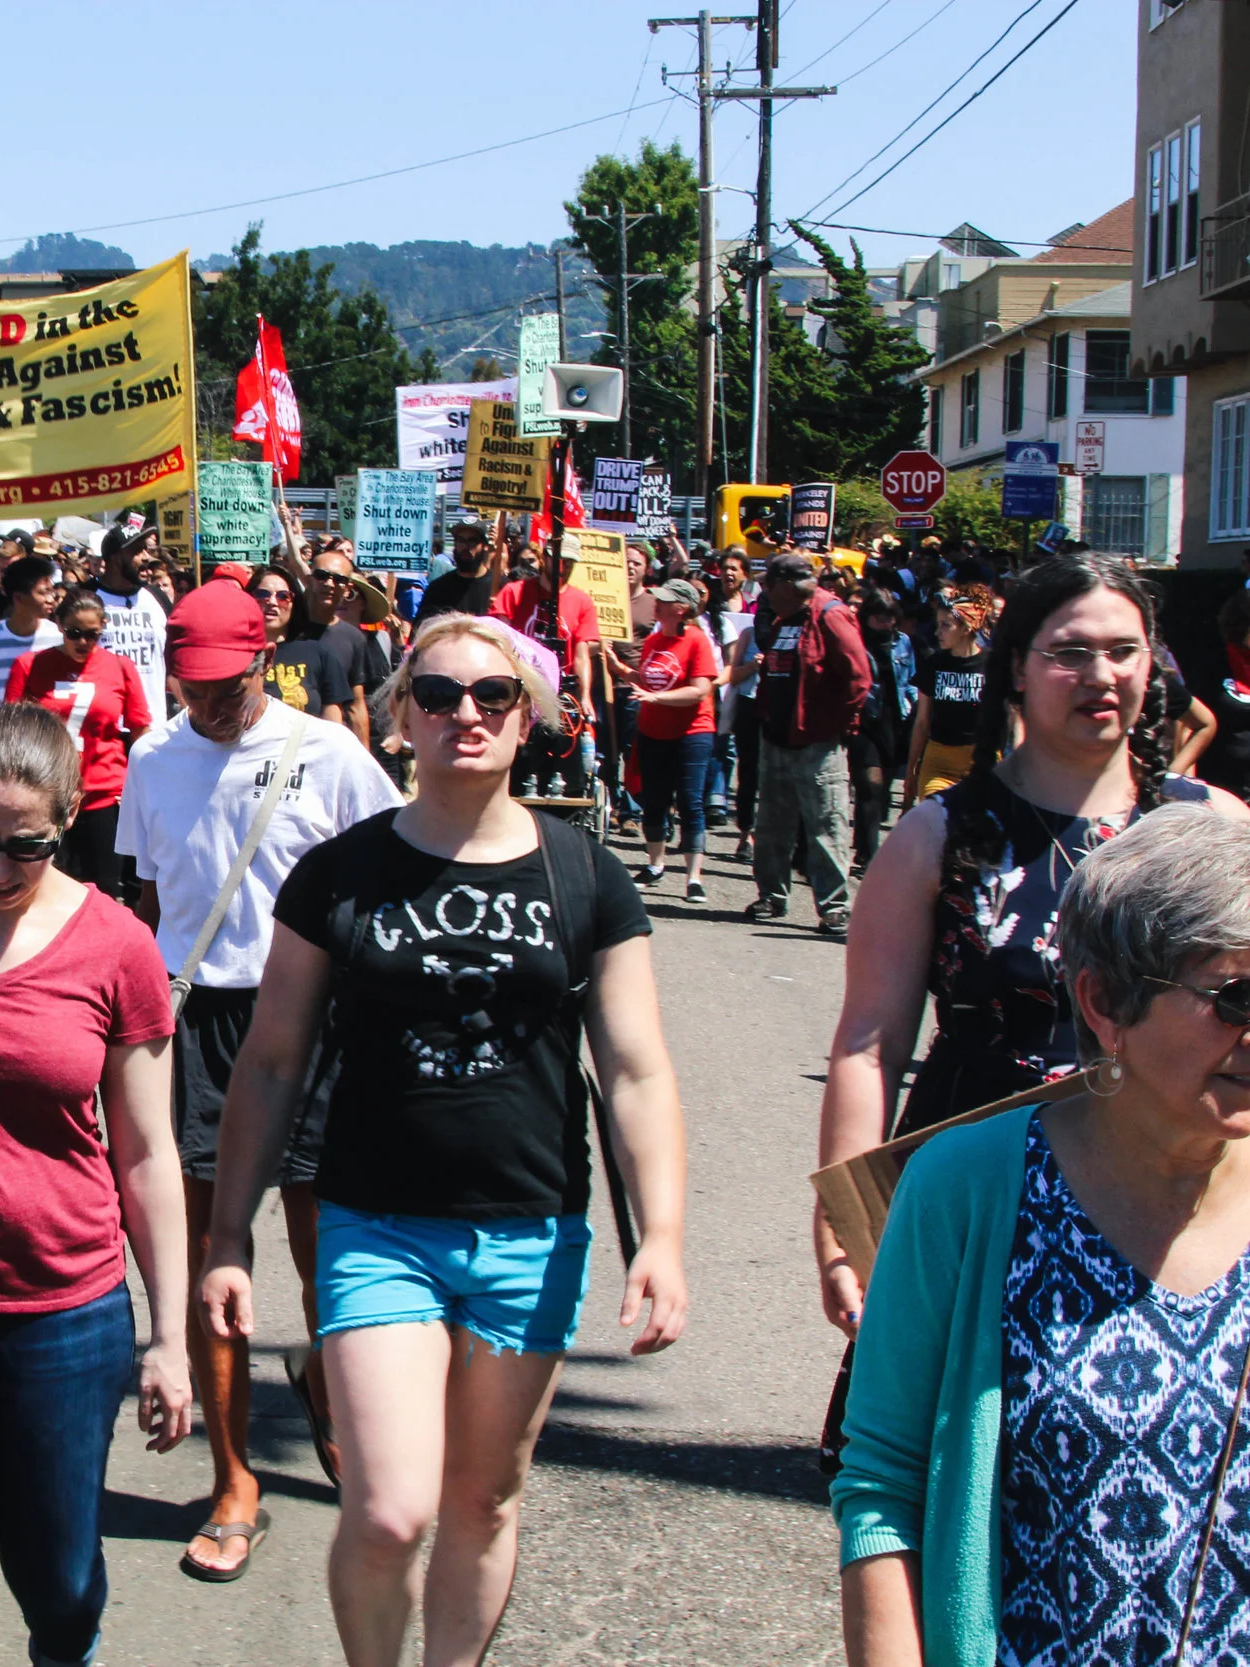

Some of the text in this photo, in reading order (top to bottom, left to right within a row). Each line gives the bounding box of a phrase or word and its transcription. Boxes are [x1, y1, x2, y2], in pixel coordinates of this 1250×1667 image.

[34, 311, 69, 341] in
[78, 299, 139, 330] the
[20, 363, 182, 426] Fascism!
[448, 411, 470, 428] Sh
[1084, 426, 1096, 436] NO
[420, 438, 467, 458] white
[481, 437, 534, 456] Against
[1077, 437, 1104, 447] PARKING
[479, 457, 523, 475] Racism
[597, 461, 640, 479] DRIVE
[50, 454, 180, 497] 415-821-6545
[386, 471, 398, 482] The
[401, 472, 414, 483] Bay
[417, 472, 434, 483] Area
[641, 474, 663, 486] CAN
[886, 471, 941, 494] STOP
[481, 477, 528, 495] Bigotry!
[597, 478, 639, 492] TRUMP
[200, 497, 228, 511] Shut
[233, 498, 265, 512] down
[406, 497, 430, 506] House
[638, 498, 671, 515] ILL?
[364, 505, 428, 519] Shut down
[217, 519, 249, 531] white
[377, 524, 411, 537] white
[199, 533, 266, 547] supremacy!
[359, 541, 429, 556] supremacy!
[587, 566, 607, 582] Text
[935, 671, 986, 687] END WHIT
[935, 686, 982, 702] SUPREMAC
[53, 681, 95, 752] 7
[373, 884, 554, 951] G.L.O.S.S.
